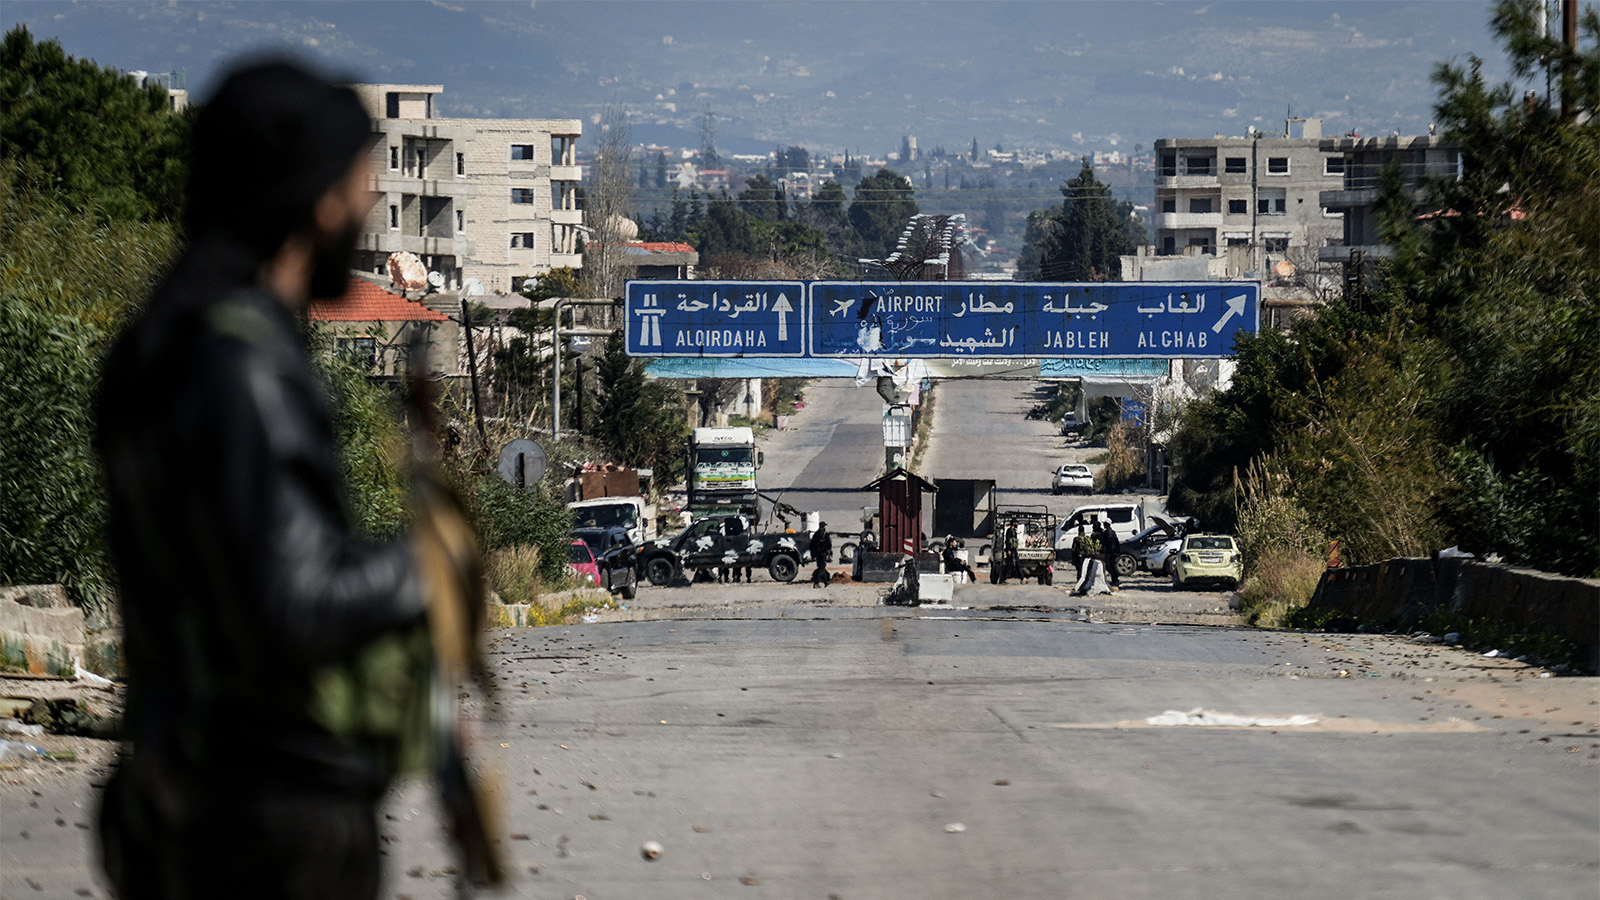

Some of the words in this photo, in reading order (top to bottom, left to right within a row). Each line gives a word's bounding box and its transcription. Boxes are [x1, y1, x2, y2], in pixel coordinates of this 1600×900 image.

[676, 291, 768, 319] القرداحة
[876, 296, 943, 313] AIRPORT
[952, 292, 1014, 318] مطار
[1042, 293, 1109, 320] جبلة
[1137, 292, 1206, 319] الغاب
[675, 329, 767, 347] ALQIRDAHA
[939, 327, 1015, 354] الشهيد
[1043, 330, 1109, 348] JABLEH
